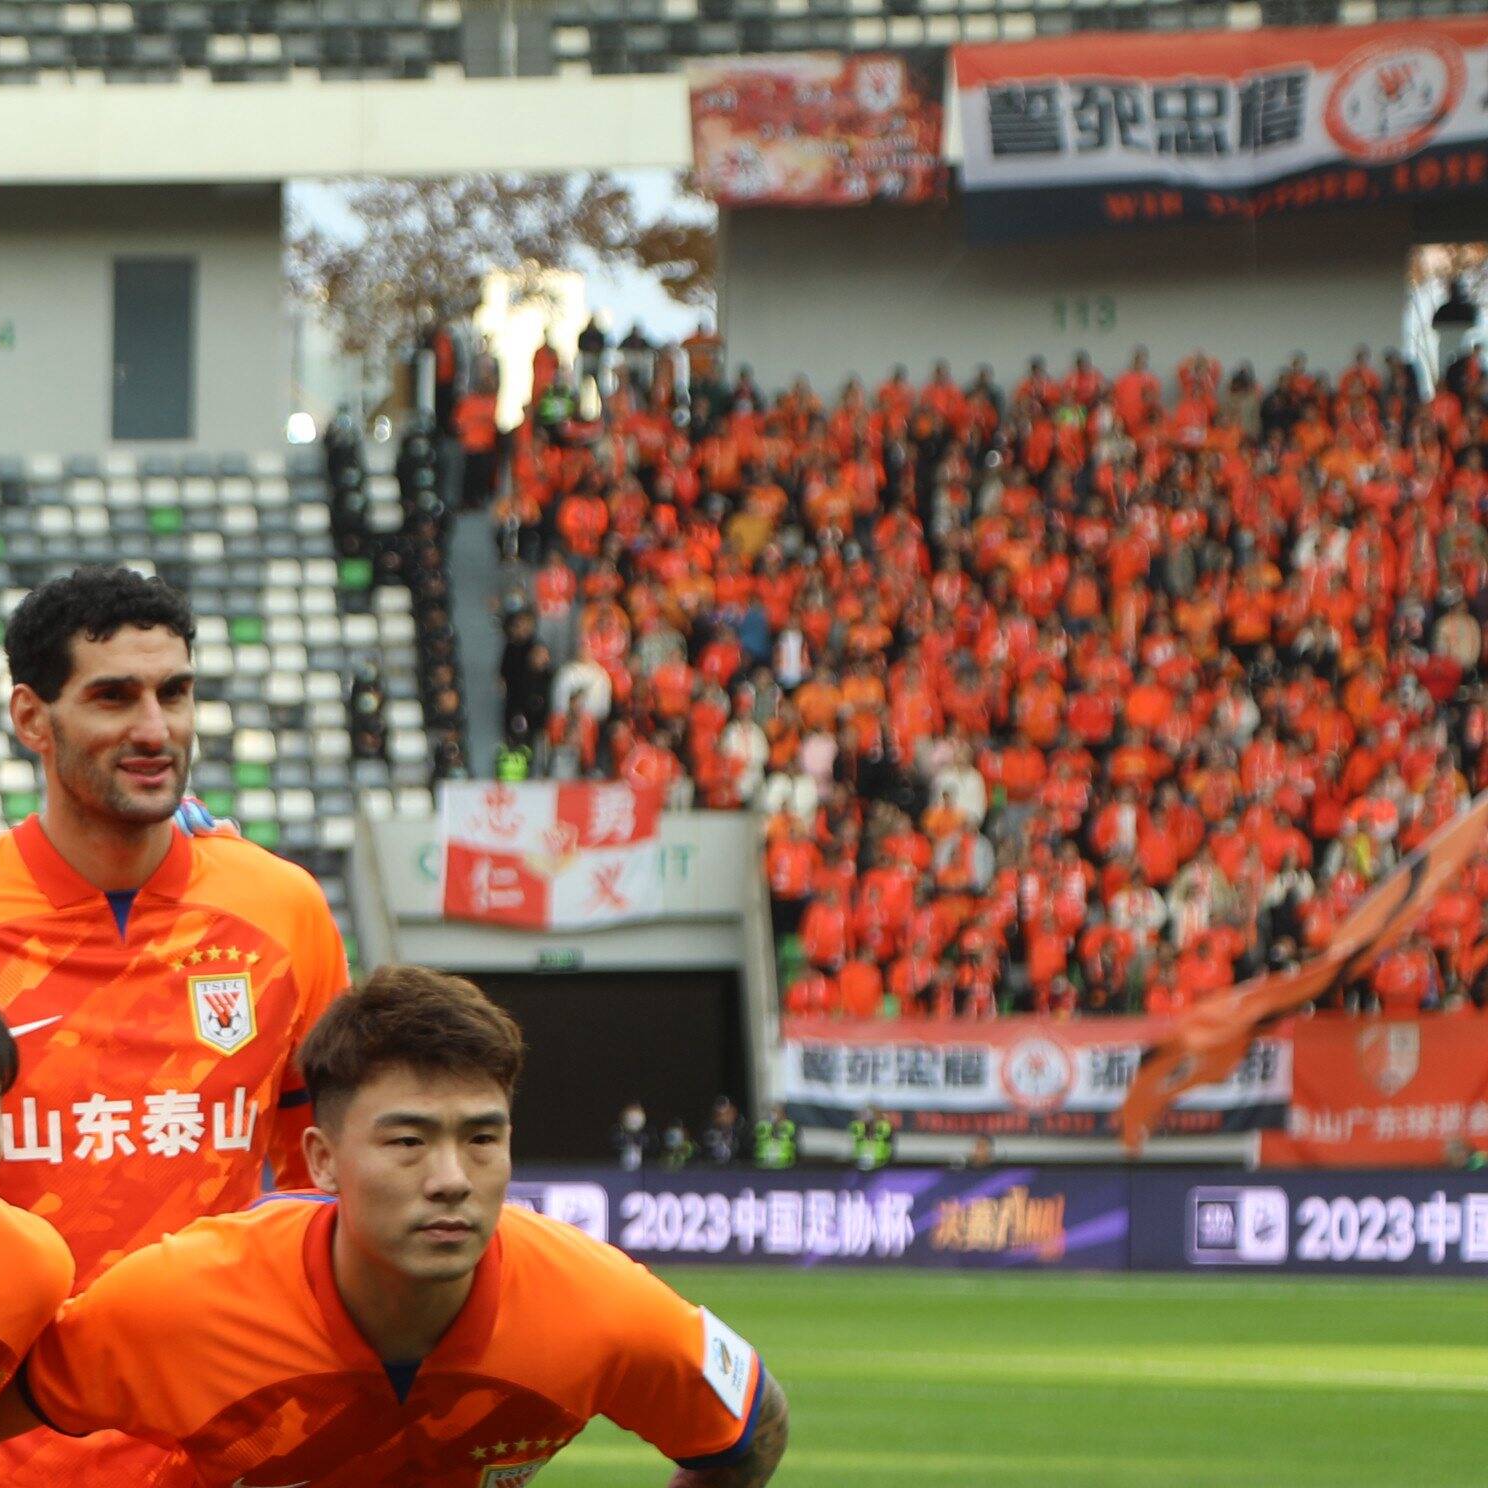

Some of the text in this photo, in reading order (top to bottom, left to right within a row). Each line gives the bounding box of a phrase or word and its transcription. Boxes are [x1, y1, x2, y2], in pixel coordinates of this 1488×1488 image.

[0, 1086, 258, 1164] 山东泰山
[620, 1187, 917, 1258] 2023中国足协杯
